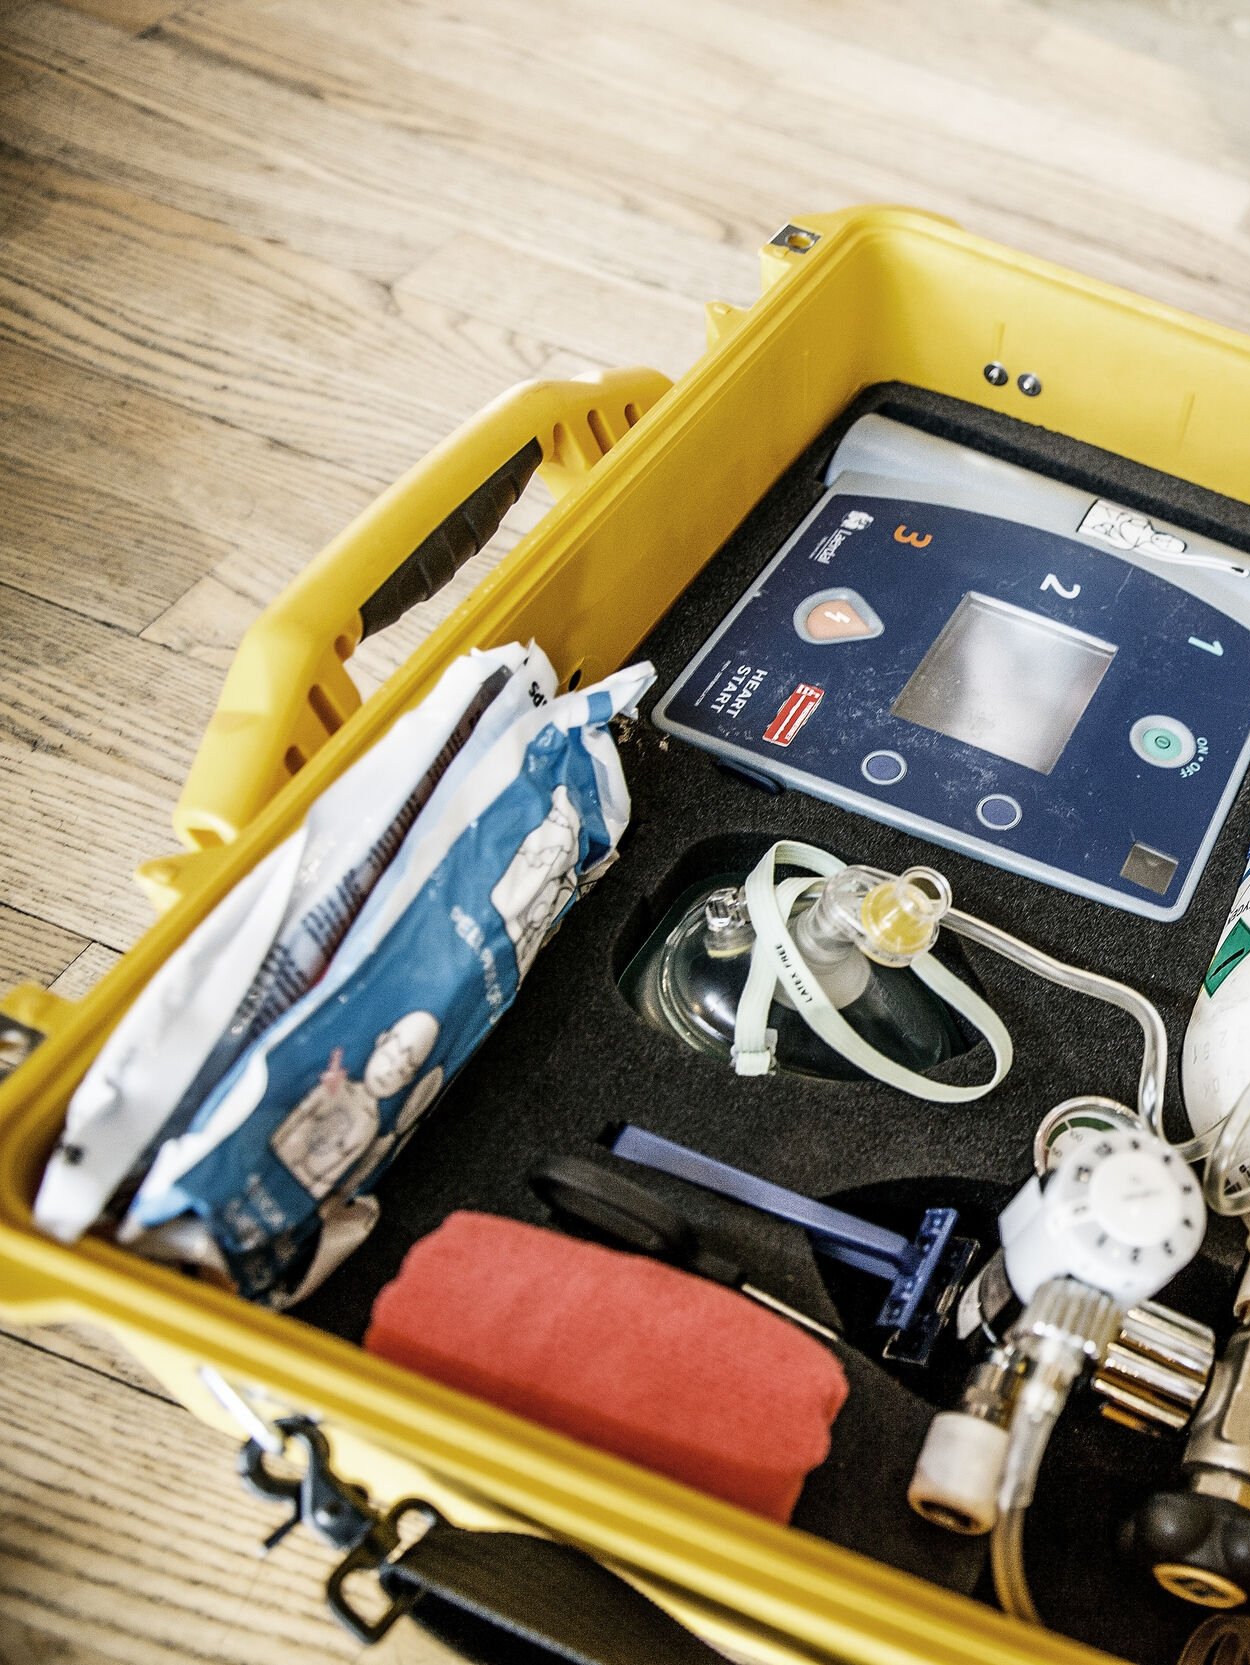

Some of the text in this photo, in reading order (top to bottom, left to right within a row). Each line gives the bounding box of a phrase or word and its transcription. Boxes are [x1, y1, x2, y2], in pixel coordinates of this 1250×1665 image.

[893, 525, 932, 549] 3
[1039, 572, 1081, 599] 2
[1188, 635, 1224, 657] 1
[710, 665, 751, 713] START
[726, 668, 768, 718] HEART
